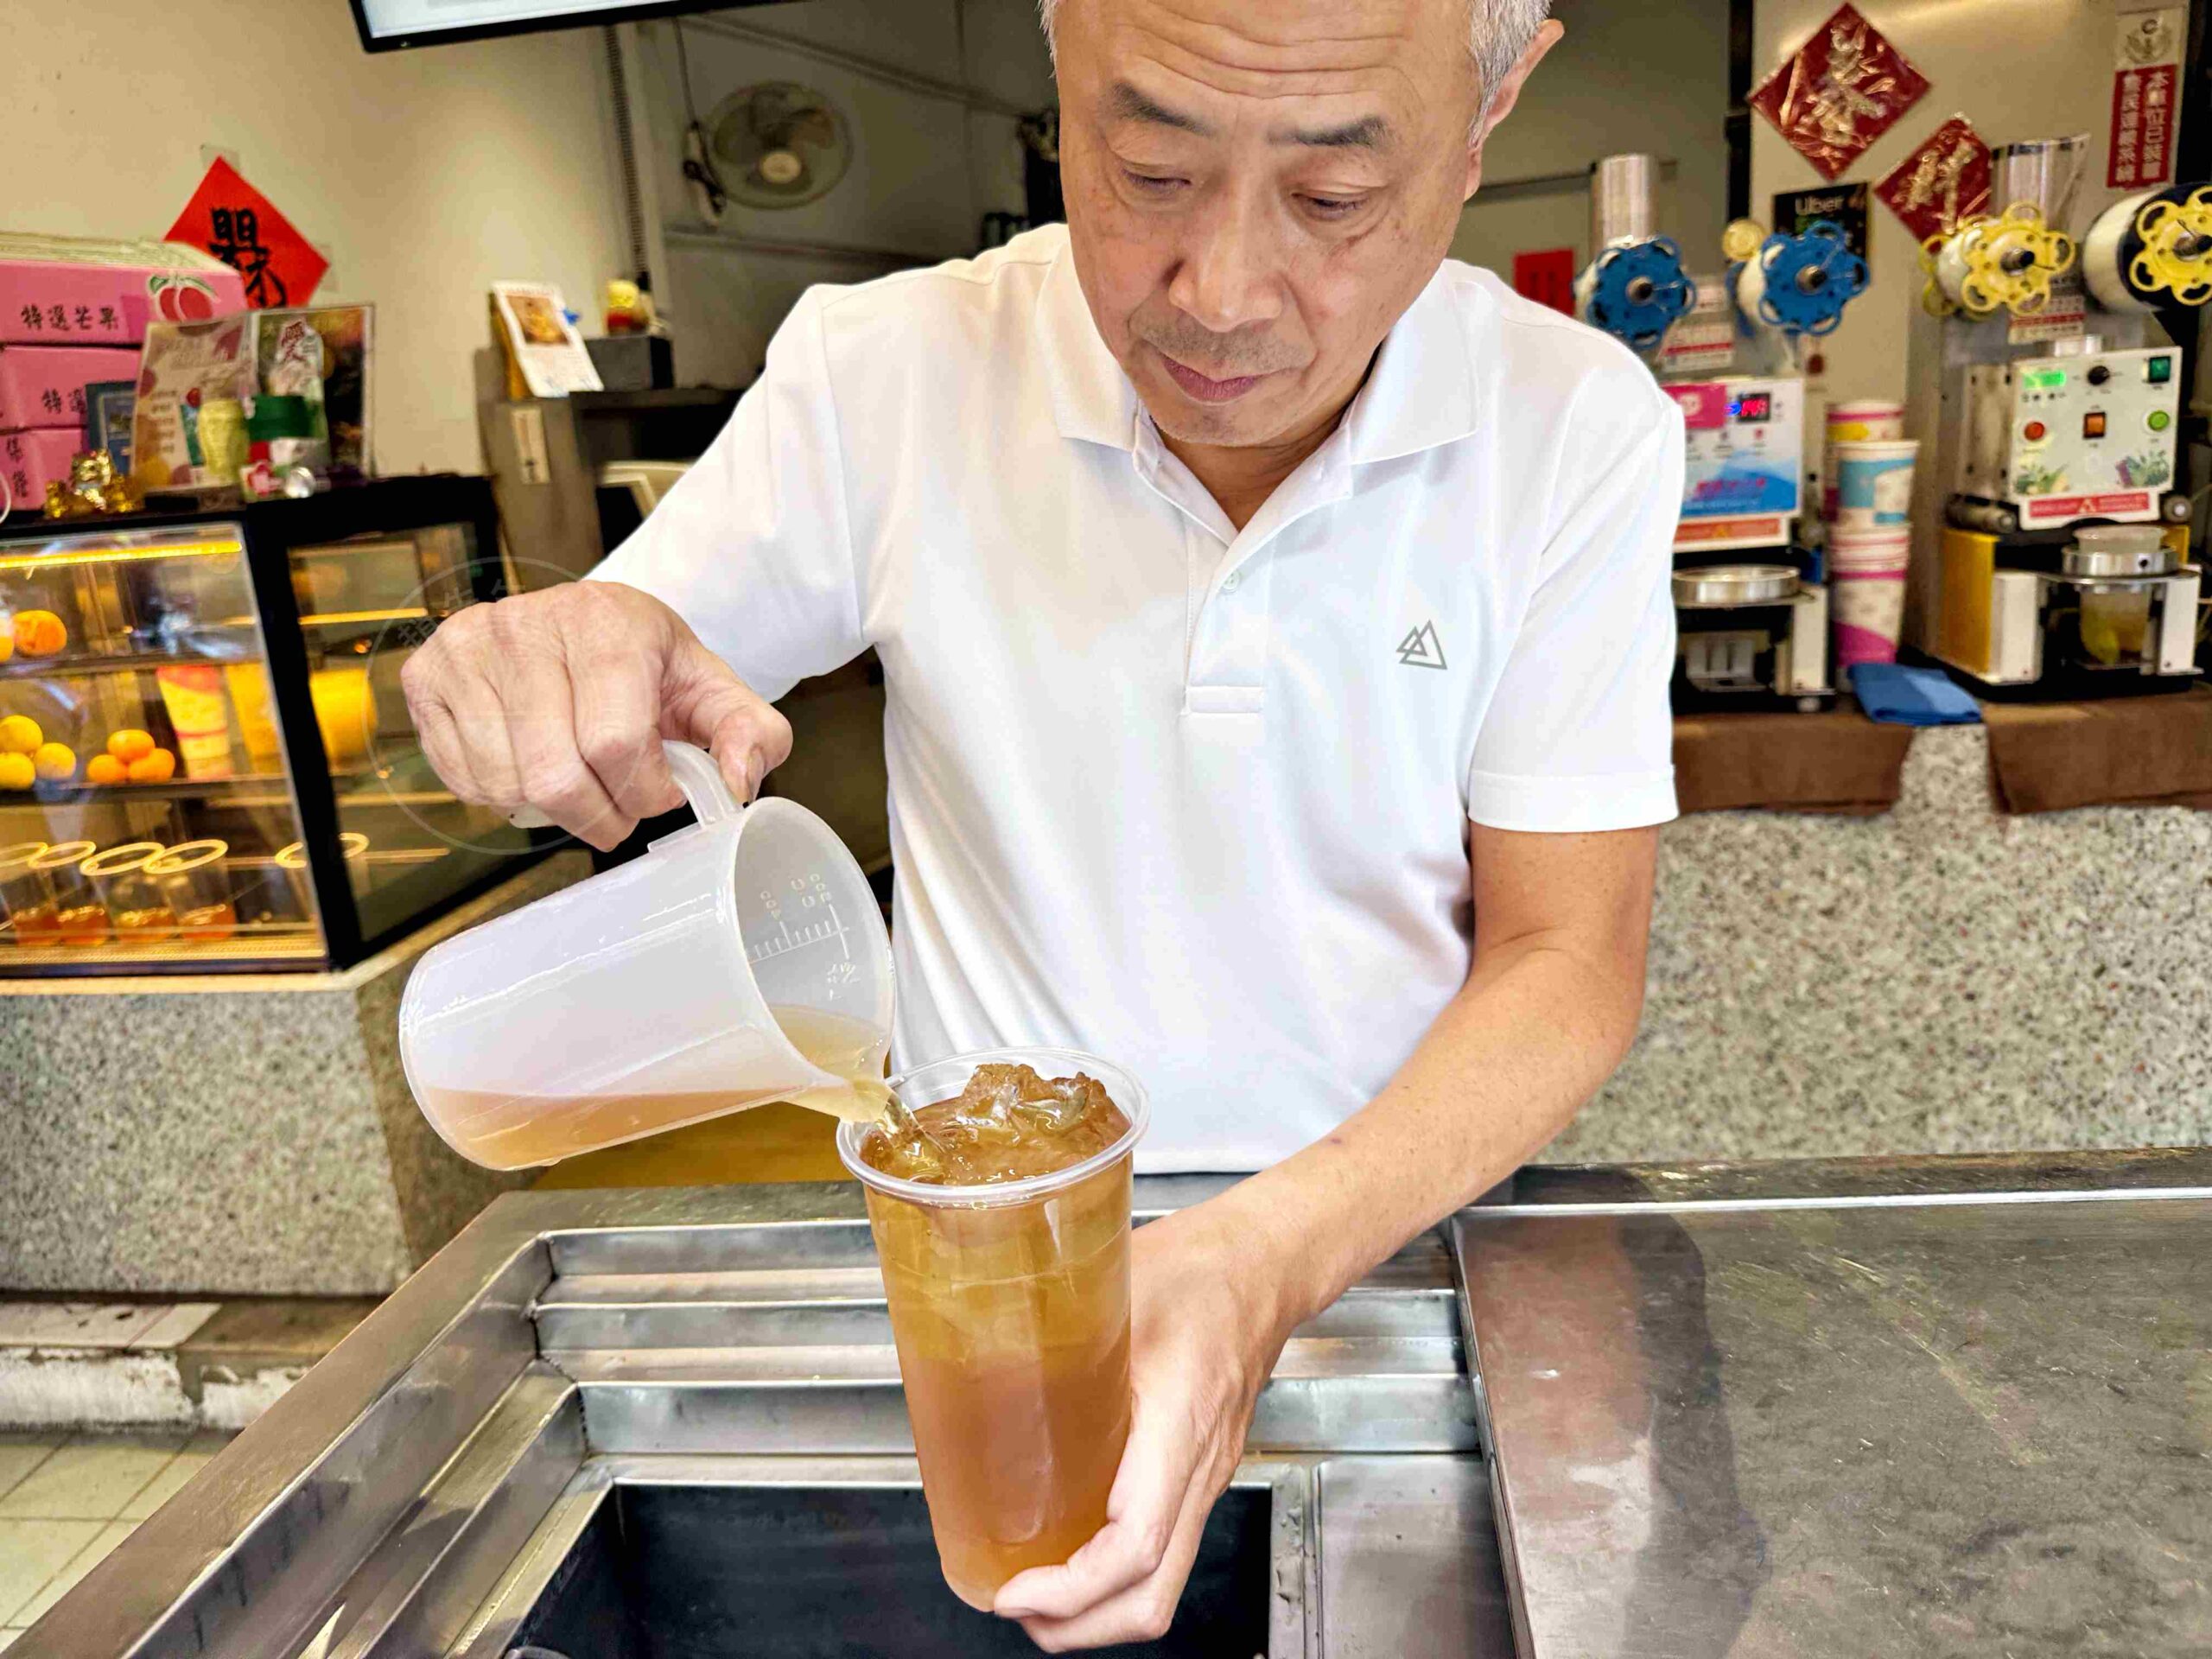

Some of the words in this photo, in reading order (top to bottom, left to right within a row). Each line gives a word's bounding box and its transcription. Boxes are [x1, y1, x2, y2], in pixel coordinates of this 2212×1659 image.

[1795, 195, 1844, 216] Uber
[21, 304, 118, 331] 特選芒果
